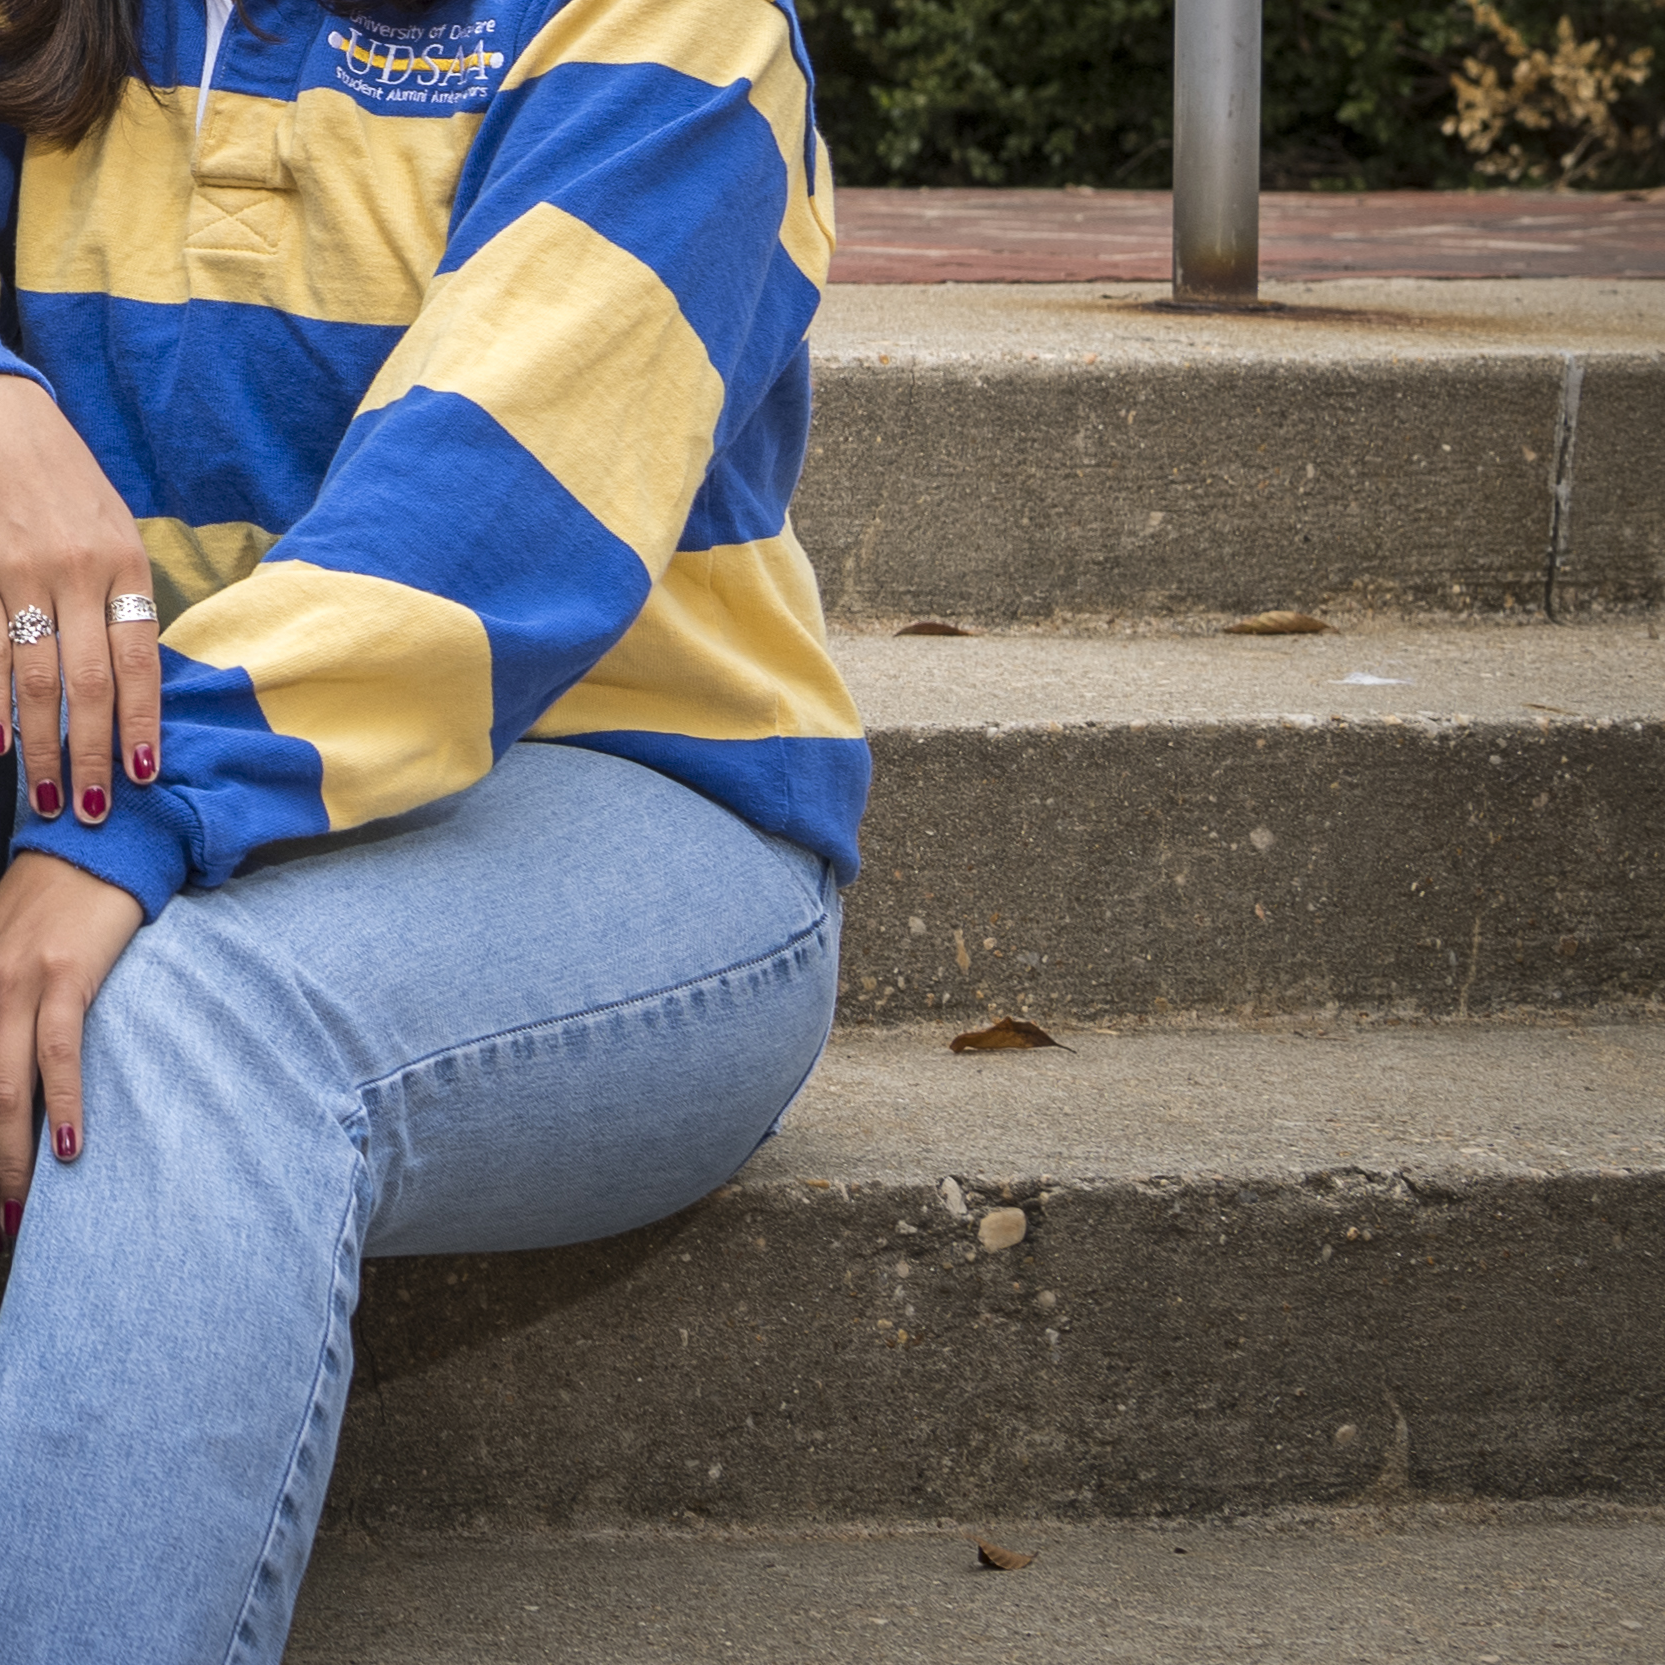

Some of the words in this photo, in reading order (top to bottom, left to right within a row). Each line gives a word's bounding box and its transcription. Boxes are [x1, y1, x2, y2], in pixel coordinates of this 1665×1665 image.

[350, 10, 423, 42] University
[429, 24, 447, 39] of
[346, 27, 489, 86] UDSAA
